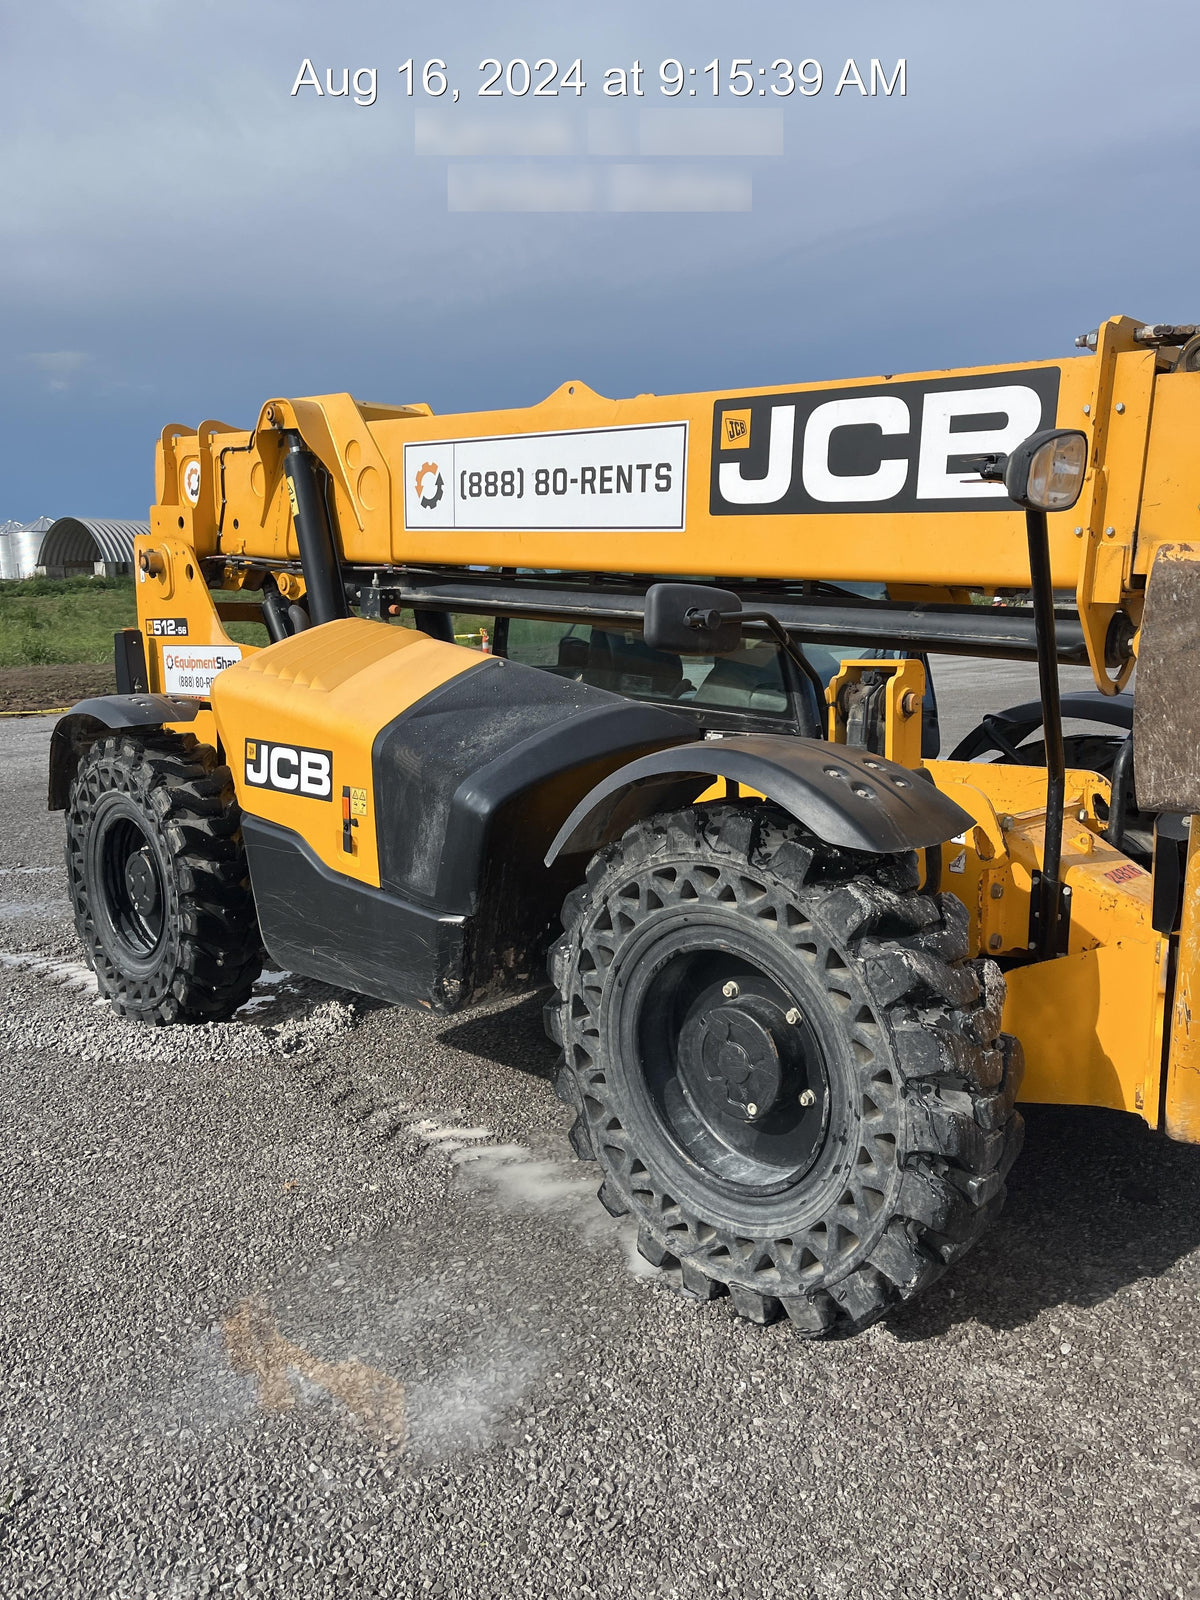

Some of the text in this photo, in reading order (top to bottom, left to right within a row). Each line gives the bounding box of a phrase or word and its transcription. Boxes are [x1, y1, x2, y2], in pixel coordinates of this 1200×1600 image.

[719, 385, 1042, 504] JCB
[729, 420, 746, 439] JCB
[460, 462, 672, 500] (888) 80-RENTS
[178, 675, 195, 688] (888)
[246, 744, 331, 796] JCB
